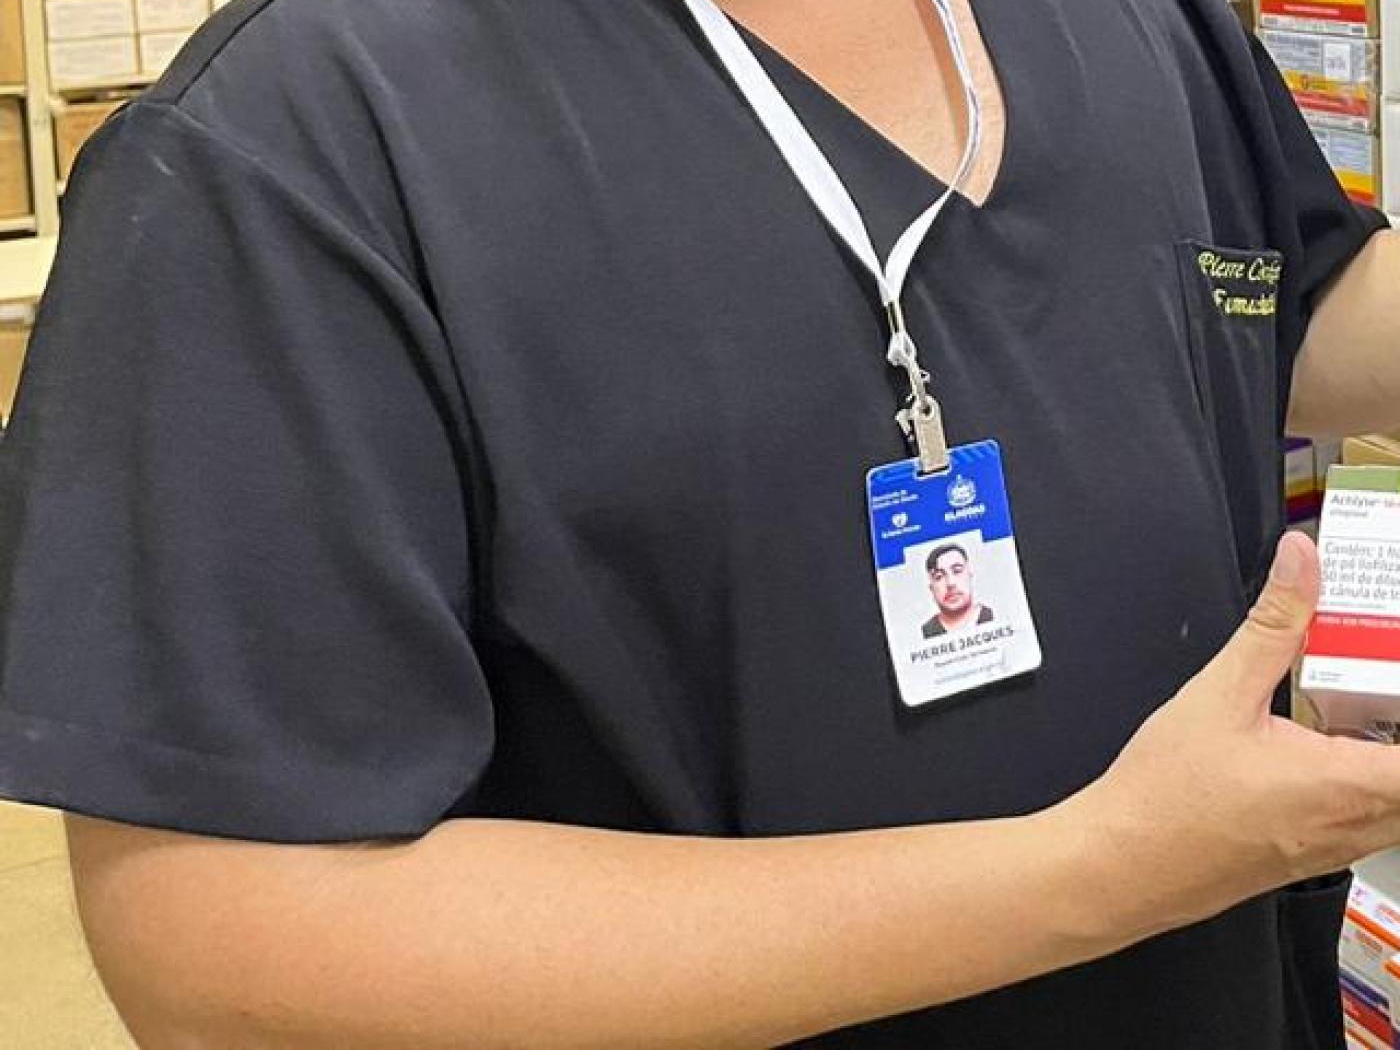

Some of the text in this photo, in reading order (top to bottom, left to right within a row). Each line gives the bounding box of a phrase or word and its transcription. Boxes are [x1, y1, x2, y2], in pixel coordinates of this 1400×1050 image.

[1357, 572, 1373, 585] de
[1372, 586, 1389, 601] de
[910, 624, 1015, 664] PIERRE JACQUES
